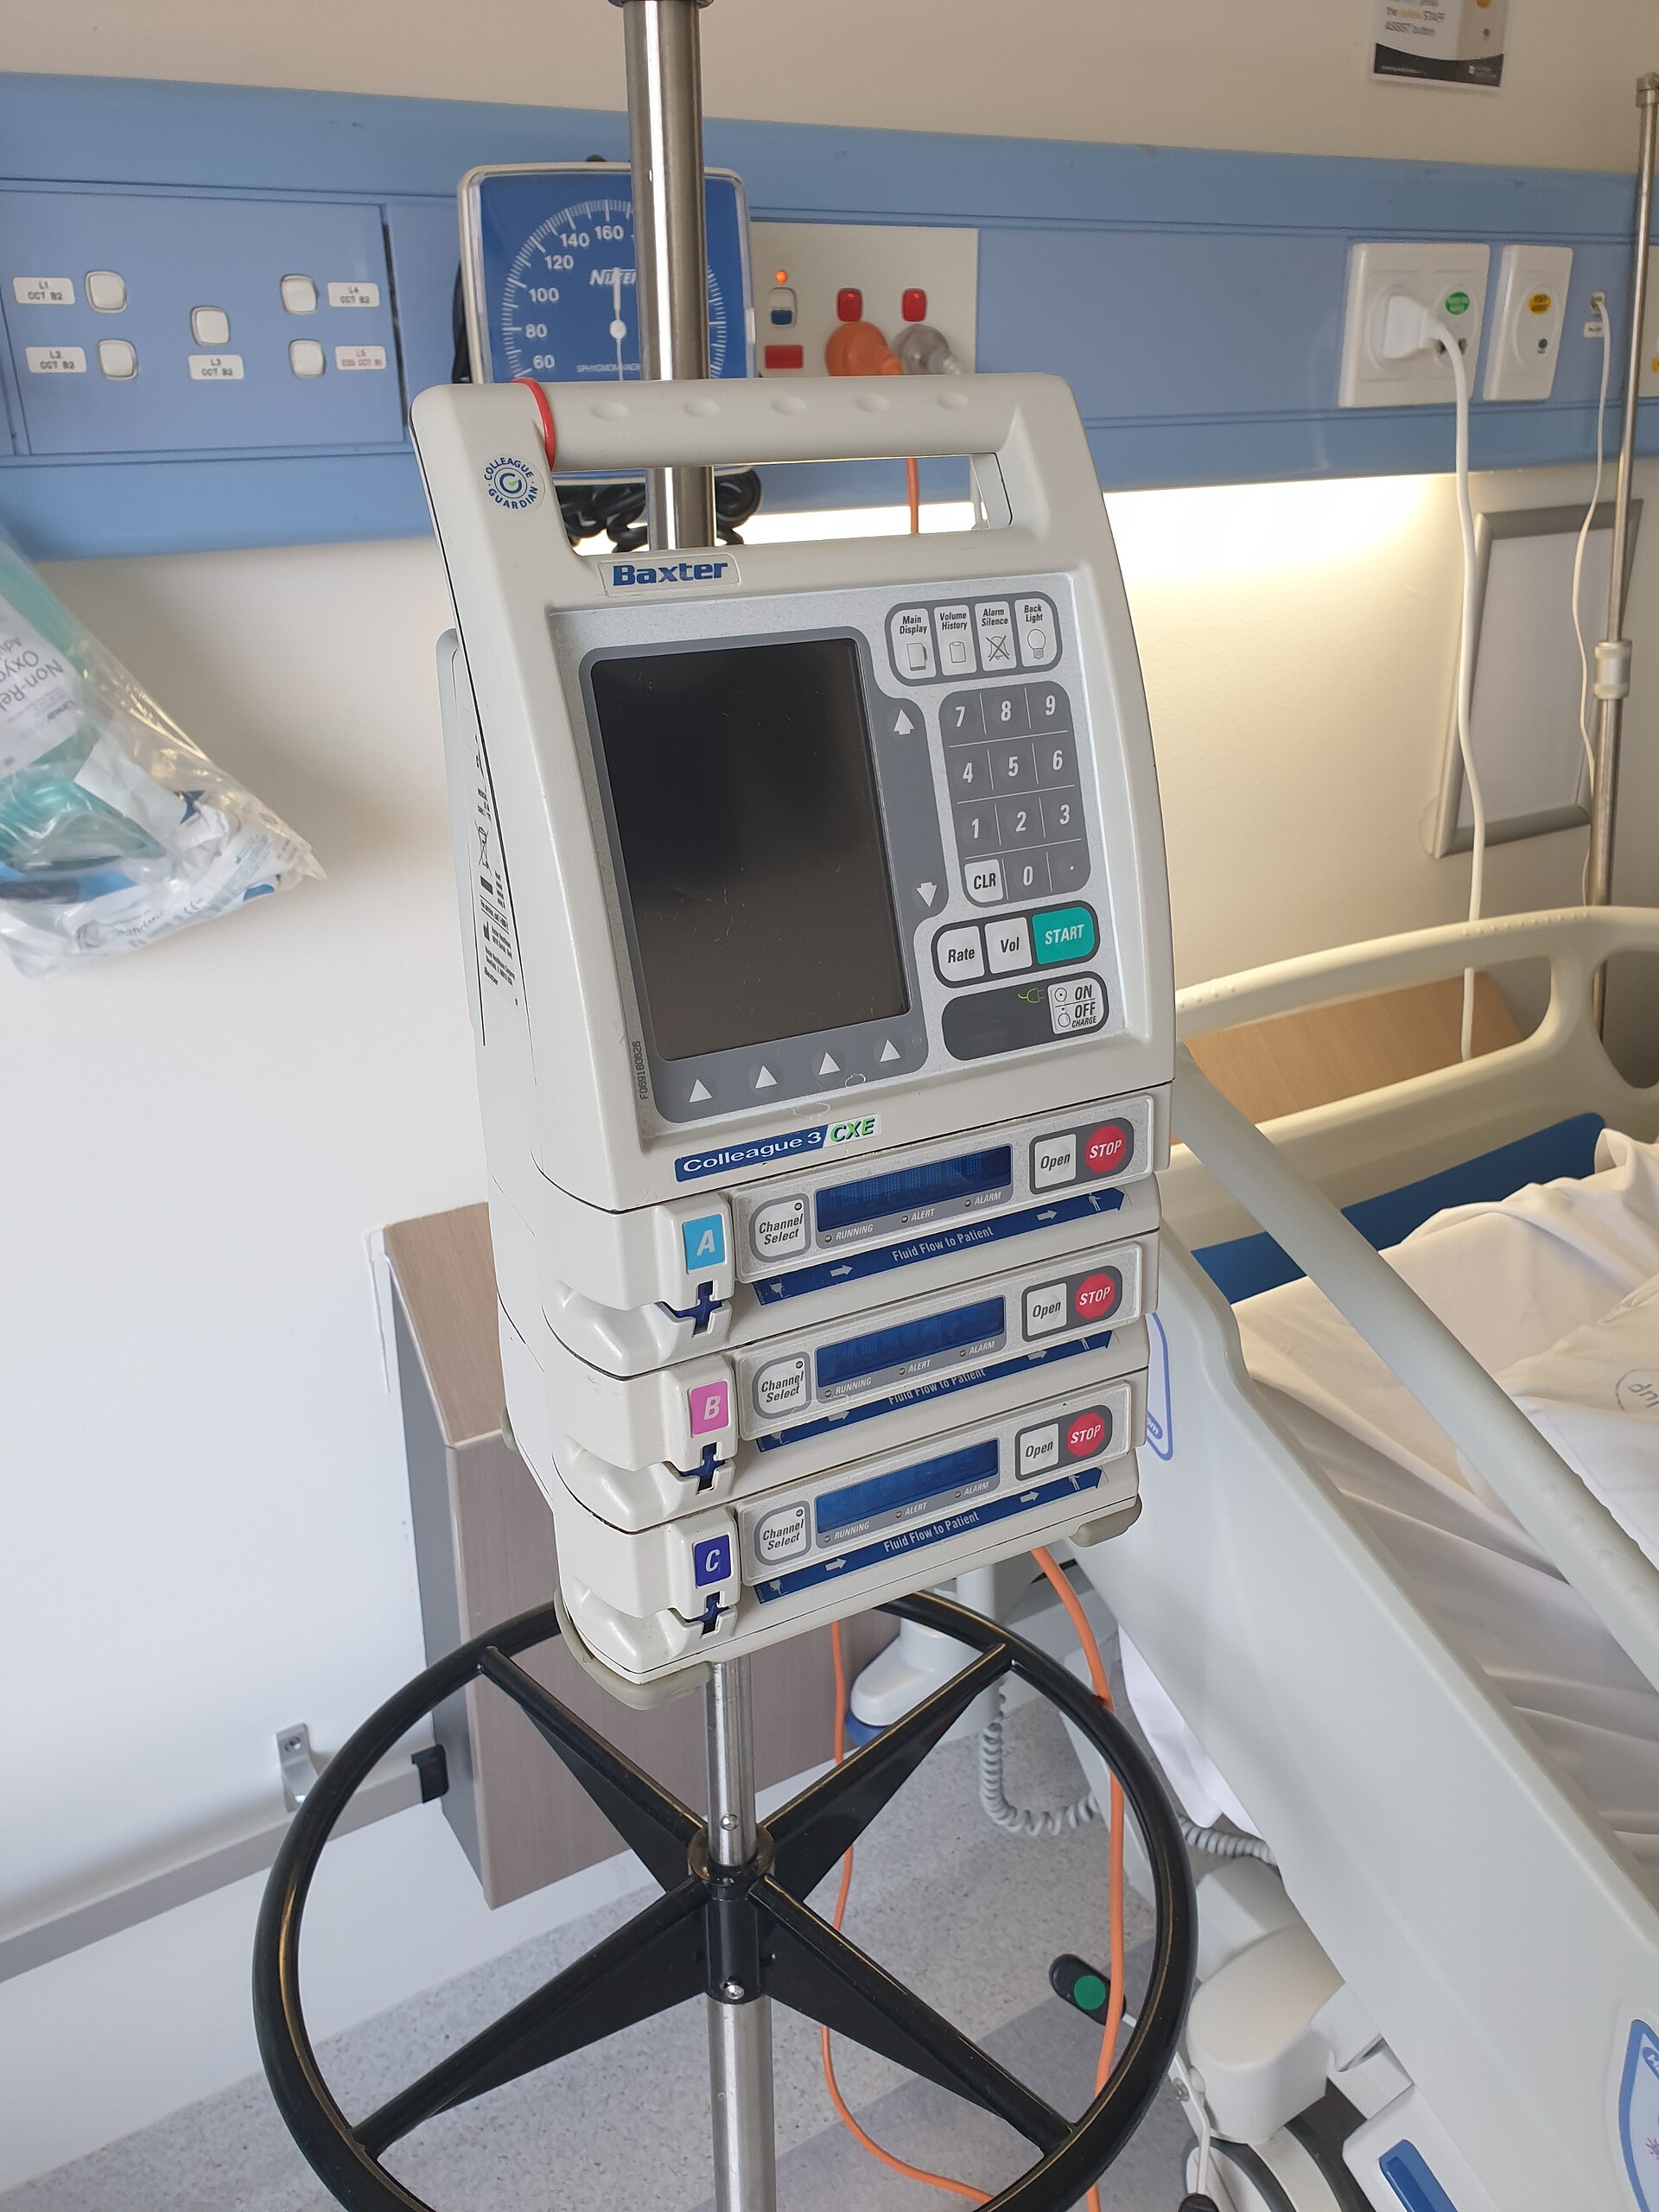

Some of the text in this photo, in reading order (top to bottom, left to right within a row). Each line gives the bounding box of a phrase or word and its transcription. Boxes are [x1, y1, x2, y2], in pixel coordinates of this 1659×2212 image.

[559, 232, 590, 248] 140
[594, 225, 624, 240] 160
[544, 254, 574, 270] 120
[529, 287, 560, 302] 100
[524, 323, 548, 338] 80
[48, 350, 61, 359] L2
[532, 354, 556, 369] 60
[484, 457, 534, 481] COLLEAGUE
[488, 486, 539, 510] GUARDIAN
[613, 562, 728, 587] Baxter
[939, 611, 967, 621] Volume
[982, 607, 1005, 617] Alarm
[1024, 604, 1042, 613] Back
[902, 615, 922, 625] Main
[942, 620, 968, 631] History
[981, 617, 1008, 627] Silence
[1026, 613, 1043, 624] Light
[899, 625, 928, 636] Display
[1001, 700, 1012, 721] 8
[1045, 695, 1056, 715] 9
[955, 706, 965, 728] 7
[1007, 756, 1020, 777] 5
[1052, 750, 1064, 771] 6
[963, 762, 974, 784] 4
[1015, 811, 1027, 832] 2
[1058, 804, 1071, 825] 3
[971, 818, 980, 840] 1
[973, 873, 996, 891] CLR
[1023, 865, 1033, 887] 0
[1045, 923, 1084, 946] START
[948, 946, 975, 964] Rate
[1000, 937, 1020, 955] Vol
[1074, 983, 1092, 1001] ON
[1074, 1001, 1096, 1019] OFF
[1071, 1014, 1097, 1028] CHARGE
[683, 1117, 875, 1173] Colleague 3 CXE
[1089, 1139, 1122, 1160] STOP
[1039, 1151, 1071, 1172] Open
[974, 1192, 1001, 1205] ALARM
[759, 1213, 804, 1235] Channel
[911, 1208, 935, 1221] ALERT
[764, 1228, 799, 1246] Select
[836, 1224, 874, 1241] RUNNING
[696, 1229, 715, 1256] A
[892, 1225, 994, 1262] Fluid Flow to Patient
[1078, 1286, 1111, 1306] STOP
[1032, 1300, 1061, 1319] Open
[969, 1340, 995, 1356] ALARM
[907, 1359, 931, 1374] ALERT
[761, 1370, 804, 1393] Channel
[835, 1376, 872, 1395] RUNNING
[887, 1369, 987, 1405] Fluid Flow to Patient
[766, 1384, 800, 1403] Select
[703, 1395, 721, 1421] B
[1070, 1424, 1102, 1445] STOP
[1025, 1440, 1054, 1459] Open
[963, 1481, 989, 1497] ALARM
[905, 1501, 927, 1516] ALERT
[762, 1518, 804, 1541] Channel
[834, 1521, 870, 1541] RUNNING
[883, 1510, 980, 1553] Fluid Flow to Patient
[766, 1532, 801, 1551] Select
[705, 1548, 721, 1573] C
